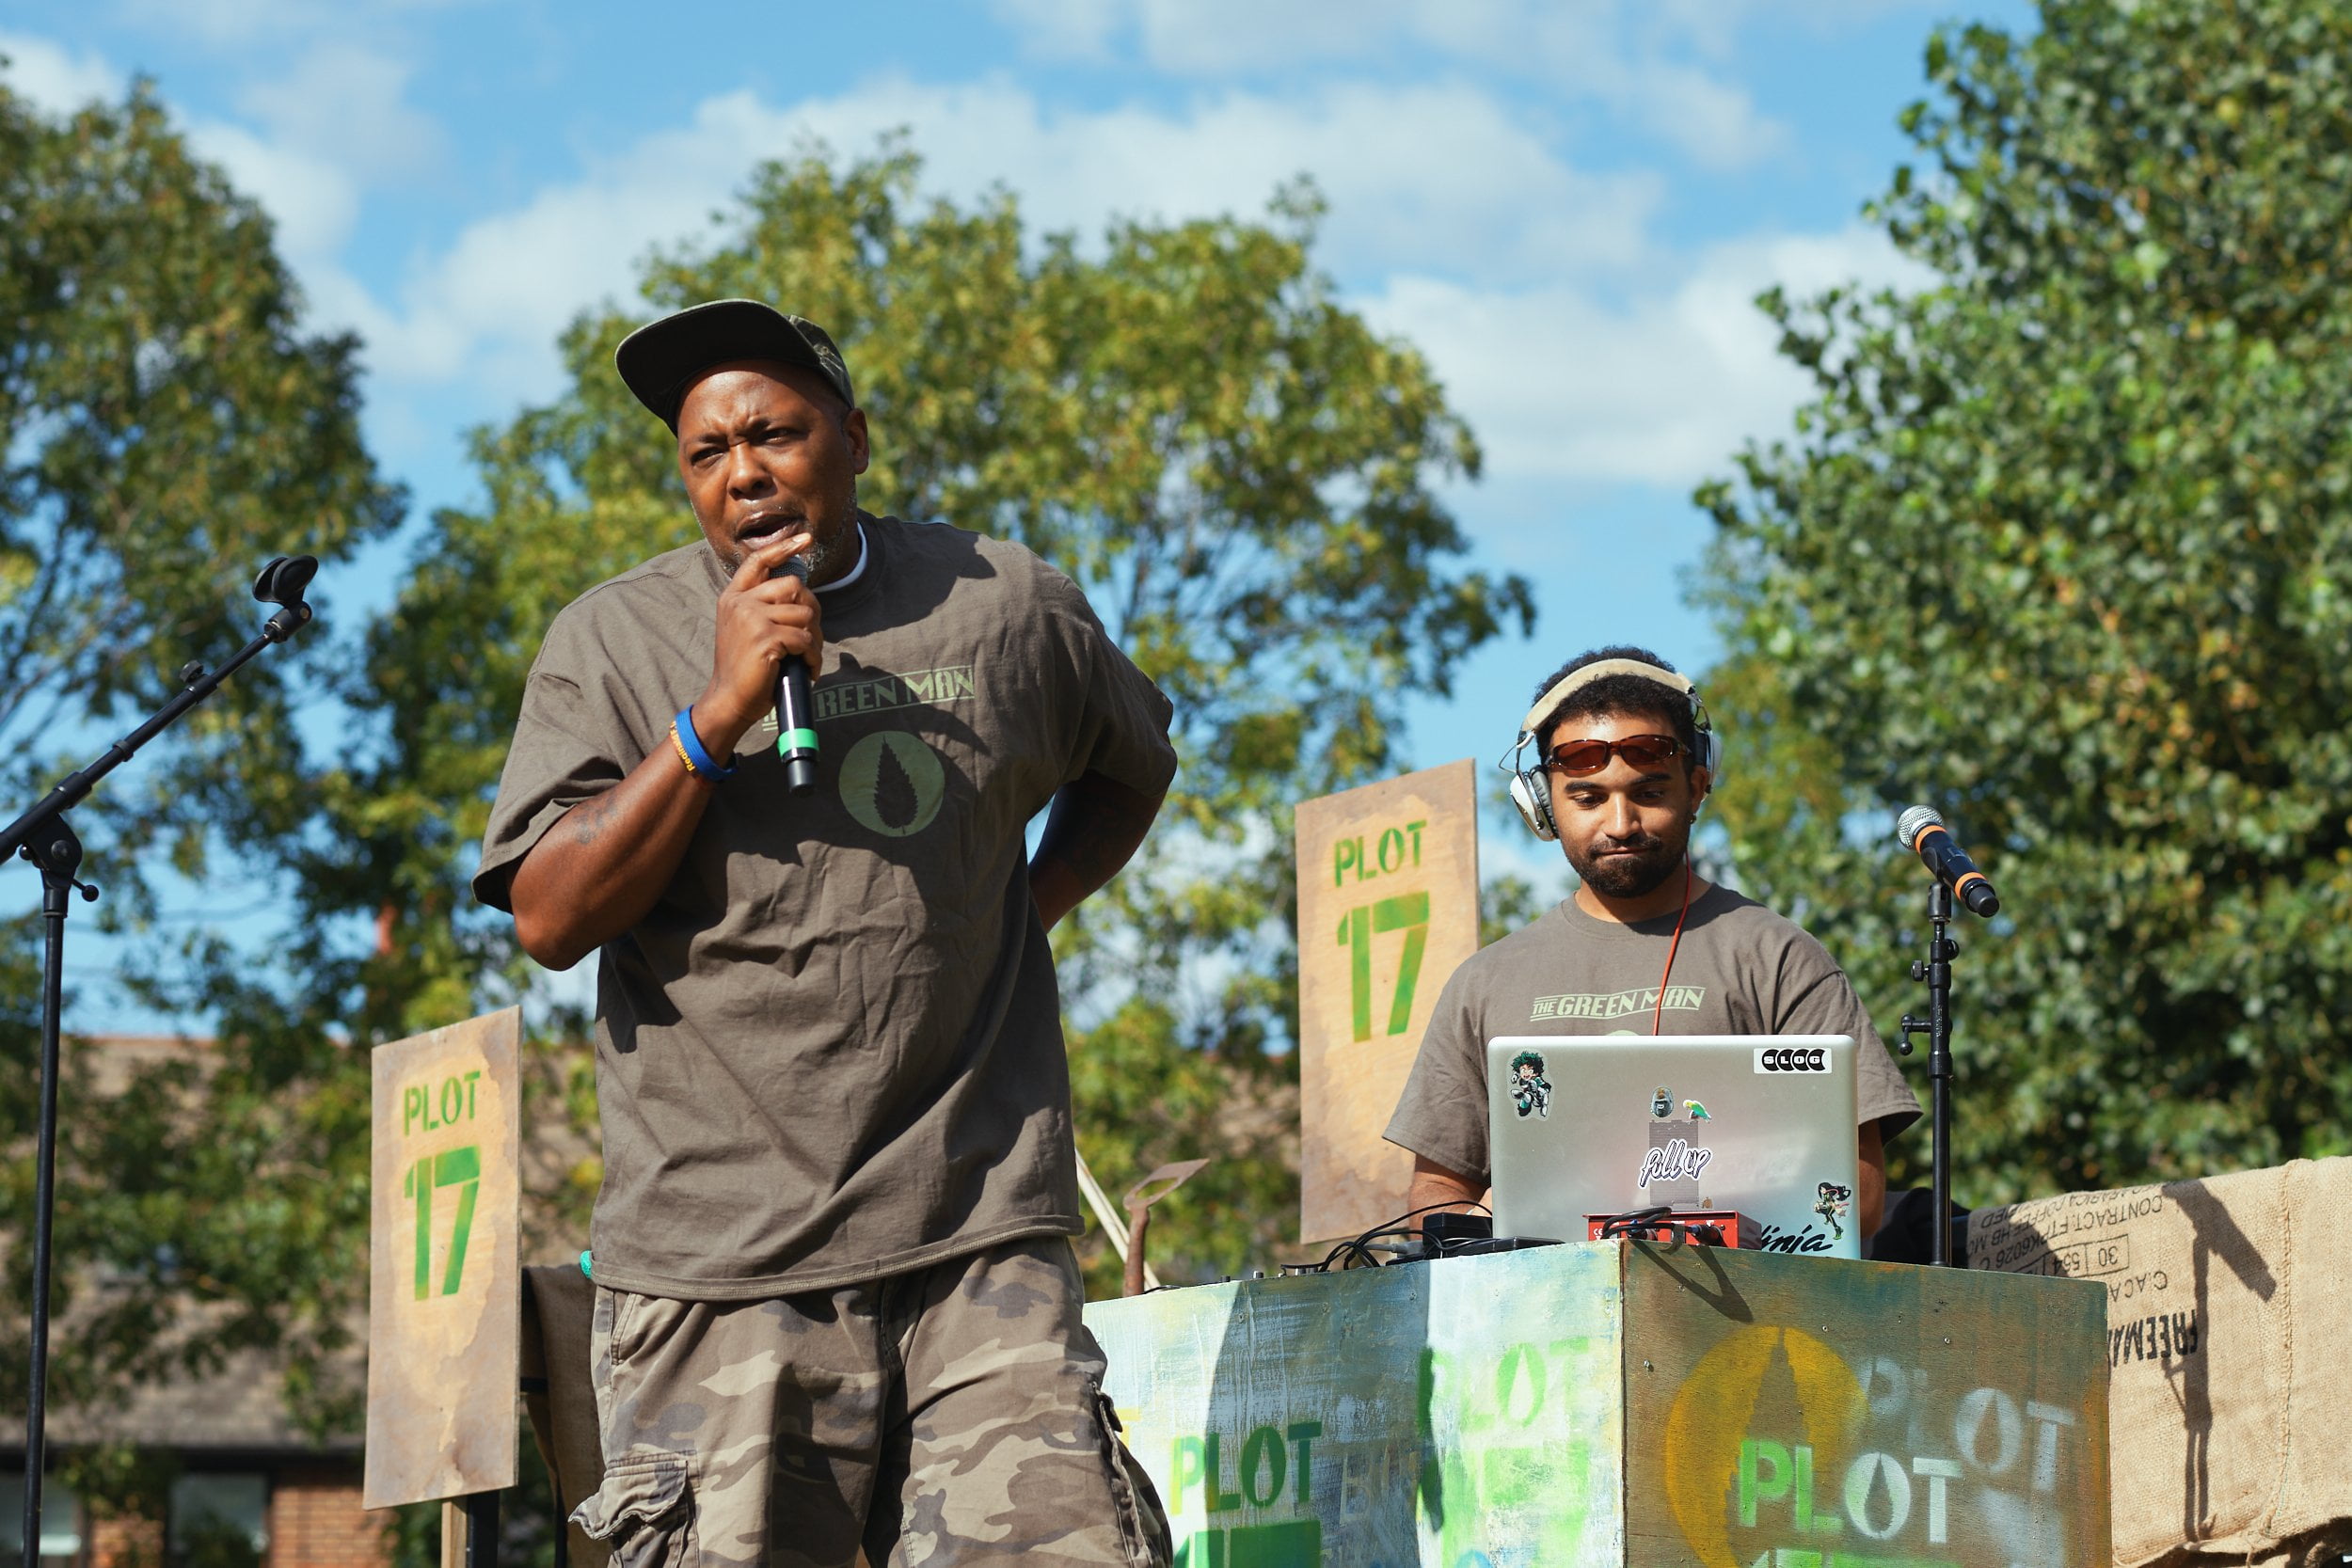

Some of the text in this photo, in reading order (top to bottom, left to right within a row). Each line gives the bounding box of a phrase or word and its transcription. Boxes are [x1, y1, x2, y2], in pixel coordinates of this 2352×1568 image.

[815, 678, 898, 720] REEN
[904, 671, 975, 704] MAN
[1334, 819, 1427, 888] PLOT
[1337, 890, 1429, 1043] 17
[1533, 988, 1705, 1018] THE GREEN MAN
[404, 1070, 481, 1136] PLOT
[405, 1146, 481, 1301] 17
[1761, 1224, 1833, 1254] inja
[2098, 1245, 2118, 1267] 30
[2107, 1309, 2198, 1369] FREEMA
[1169, 1421, 1322, 1516] PLOT
[1739, 1440, 1963, 1544] PLOT
